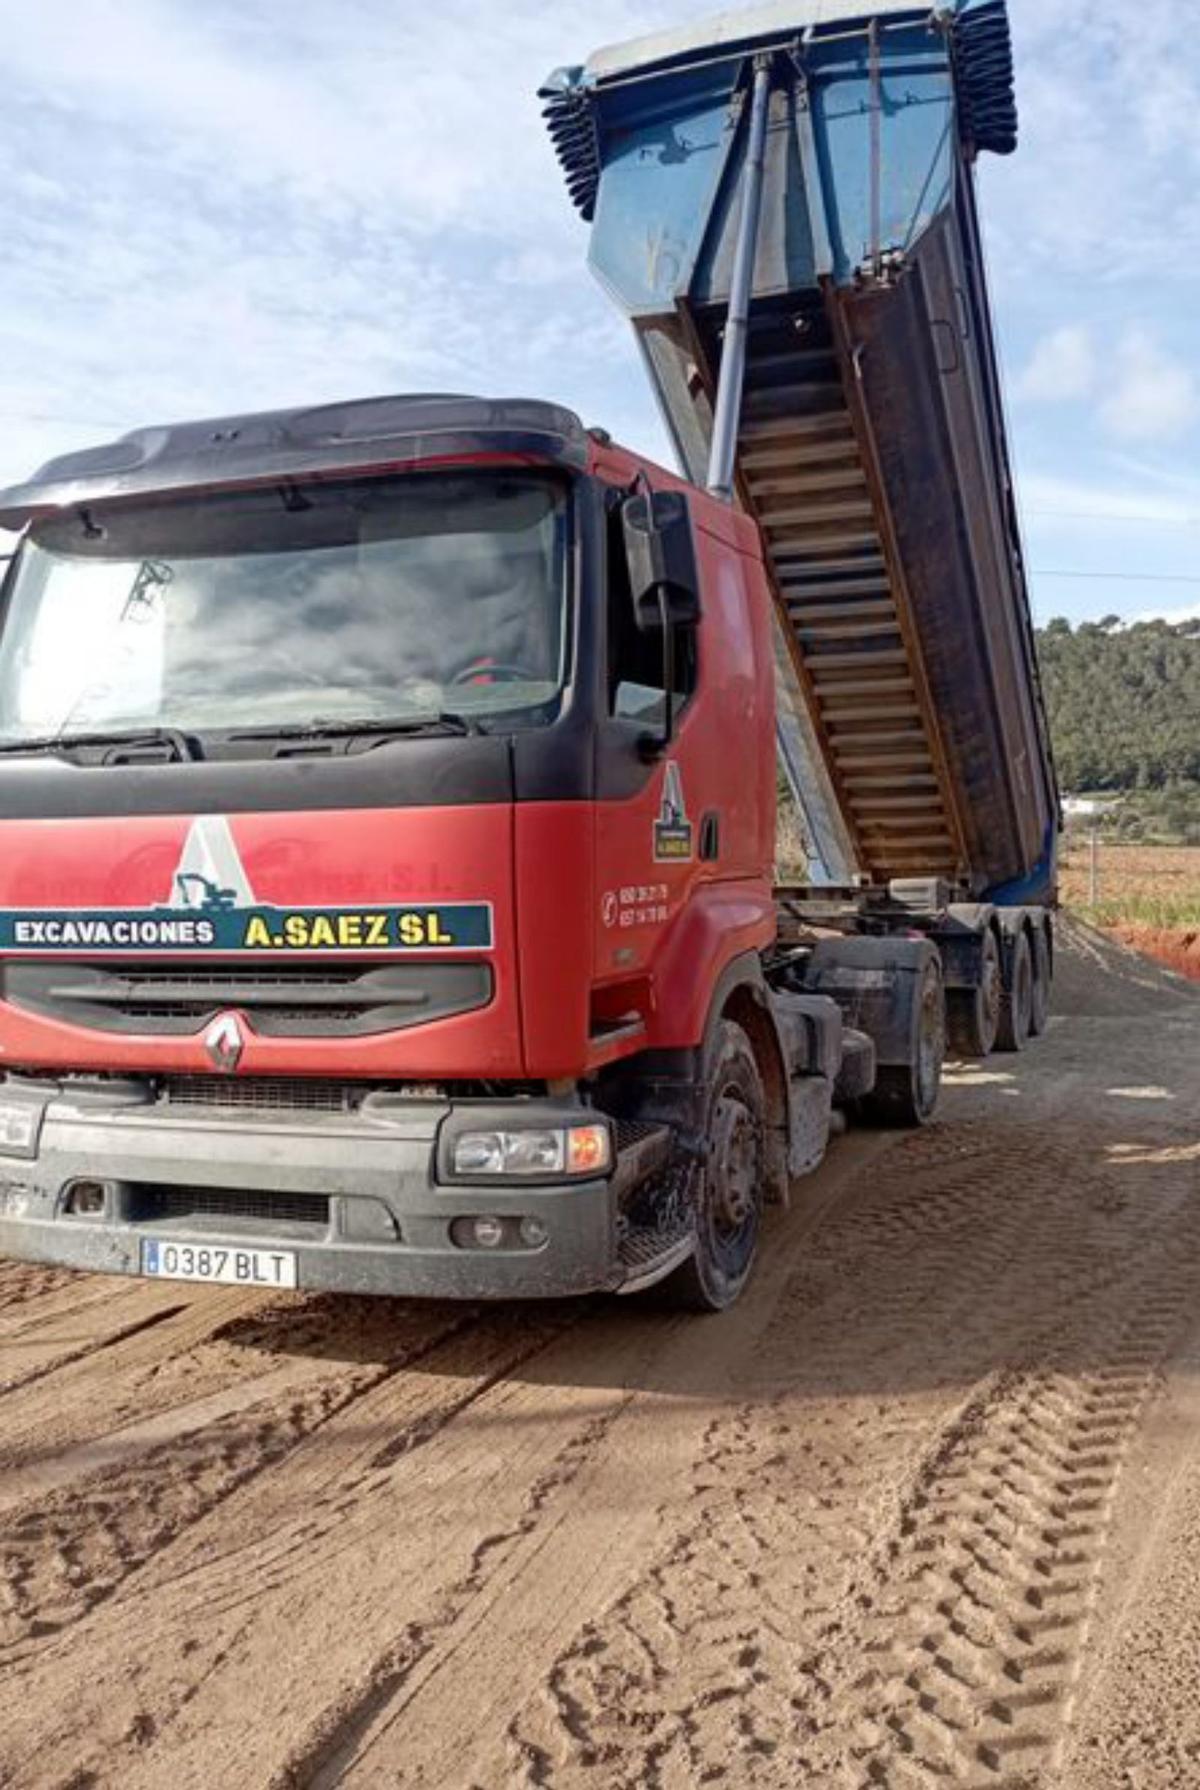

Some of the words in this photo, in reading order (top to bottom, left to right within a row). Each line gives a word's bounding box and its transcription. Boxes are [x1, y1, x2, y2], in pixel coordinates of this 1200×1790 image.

[13, 920, 215, 944] EXCAVACIONES
[244, 914, 390, 947] A.SAEZ
[399, 913, 453, 945] SL
[163, 1247, 229, 1278] 0387
[235, 1252, 286, 1283] BLT
